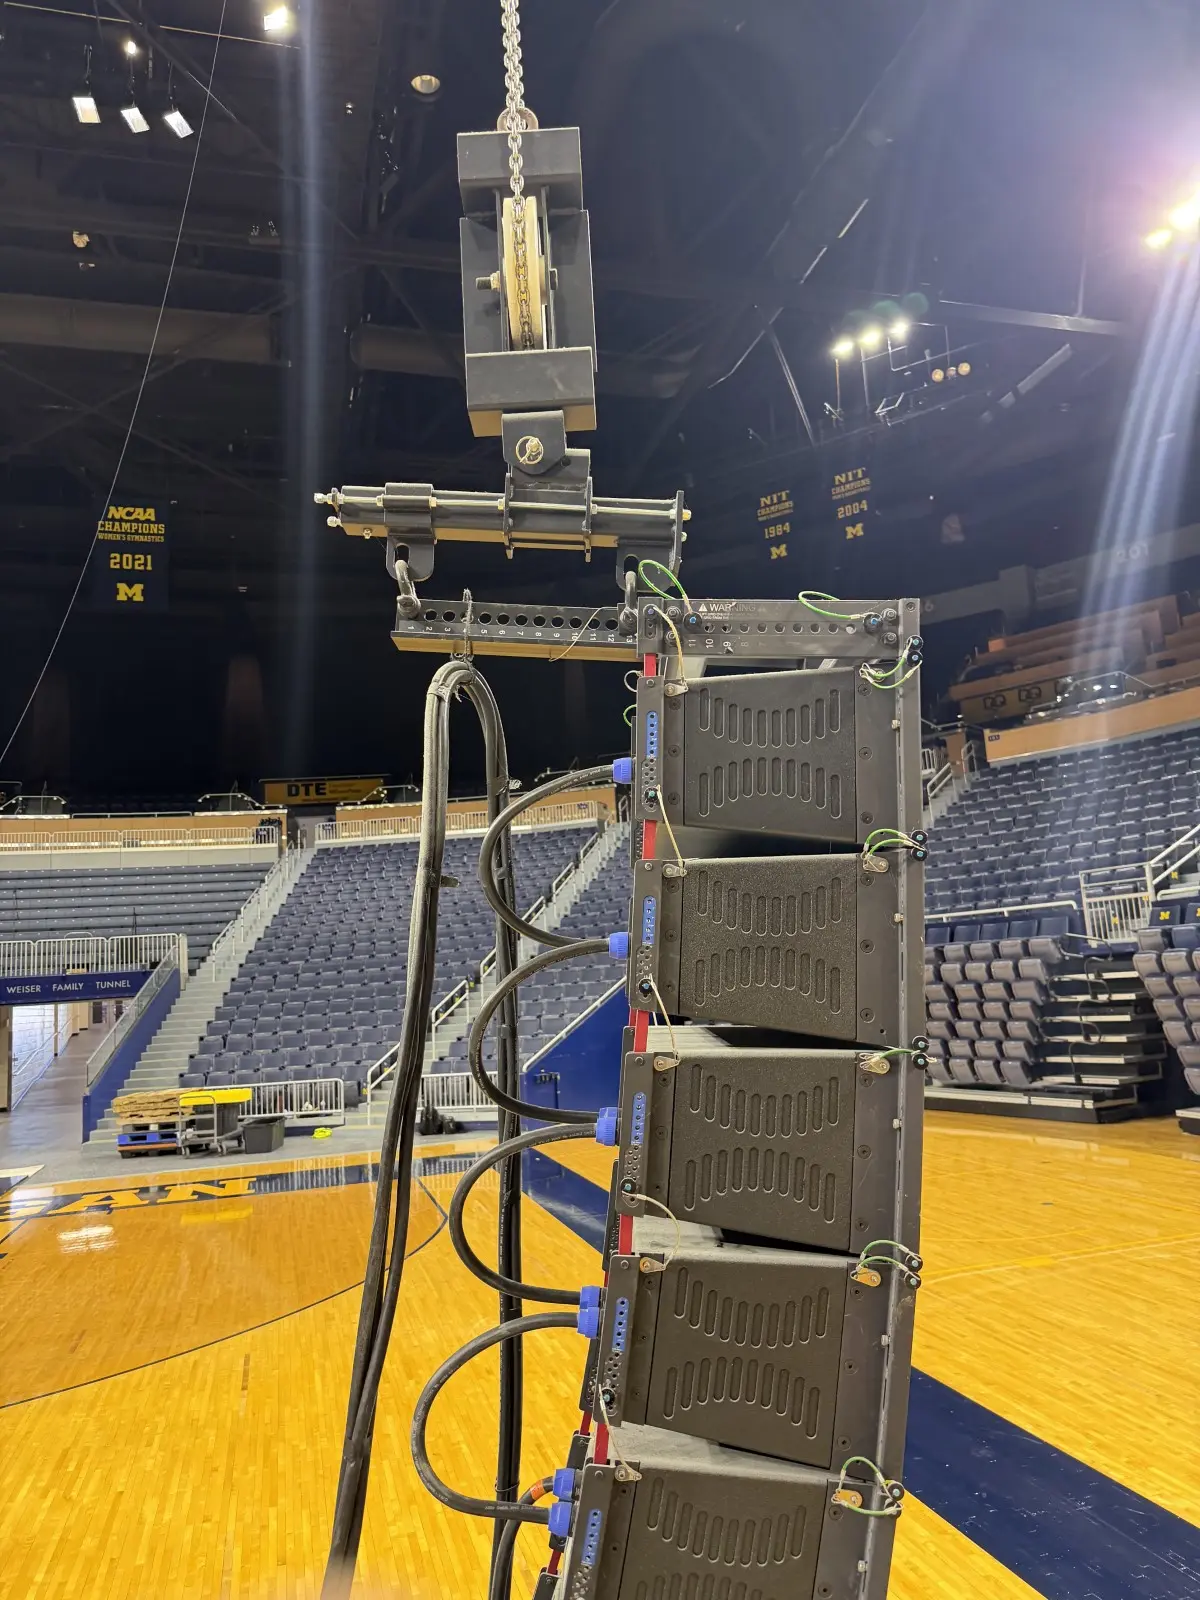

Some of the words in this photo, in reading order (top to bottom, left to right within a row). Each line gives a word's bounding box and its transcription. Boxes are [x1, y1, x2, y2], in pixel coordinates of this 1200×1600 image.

[834, 467, 866, 485] NIT
[760, 490, 790, 507] NIT
[107, 506, 156, 521] NCAA
[837, 500, 868, 519] 2004
[97, 521, 165, 534] CHAMPIONS
[764, 522, 790, 539] 1984
[846, 522, 864, 540] M
[97, 533, 126, 541] WOMEN'S
[126, 534, 165, 542] GYMNASTICS
[770, 544, 788, 559] M
[110, 553, 152, 570] 2021
[116, 582, 144, 601] M
[709, 603, 756, 612] WARNING
[706, 638, 714, 648] 10
[287, 782, 327, 797] DTE
[6, 985, 41, 994] WEISER
[52, 982, 84, 992] FAMILY
[96, 980, 131, 989] TUNNEL
